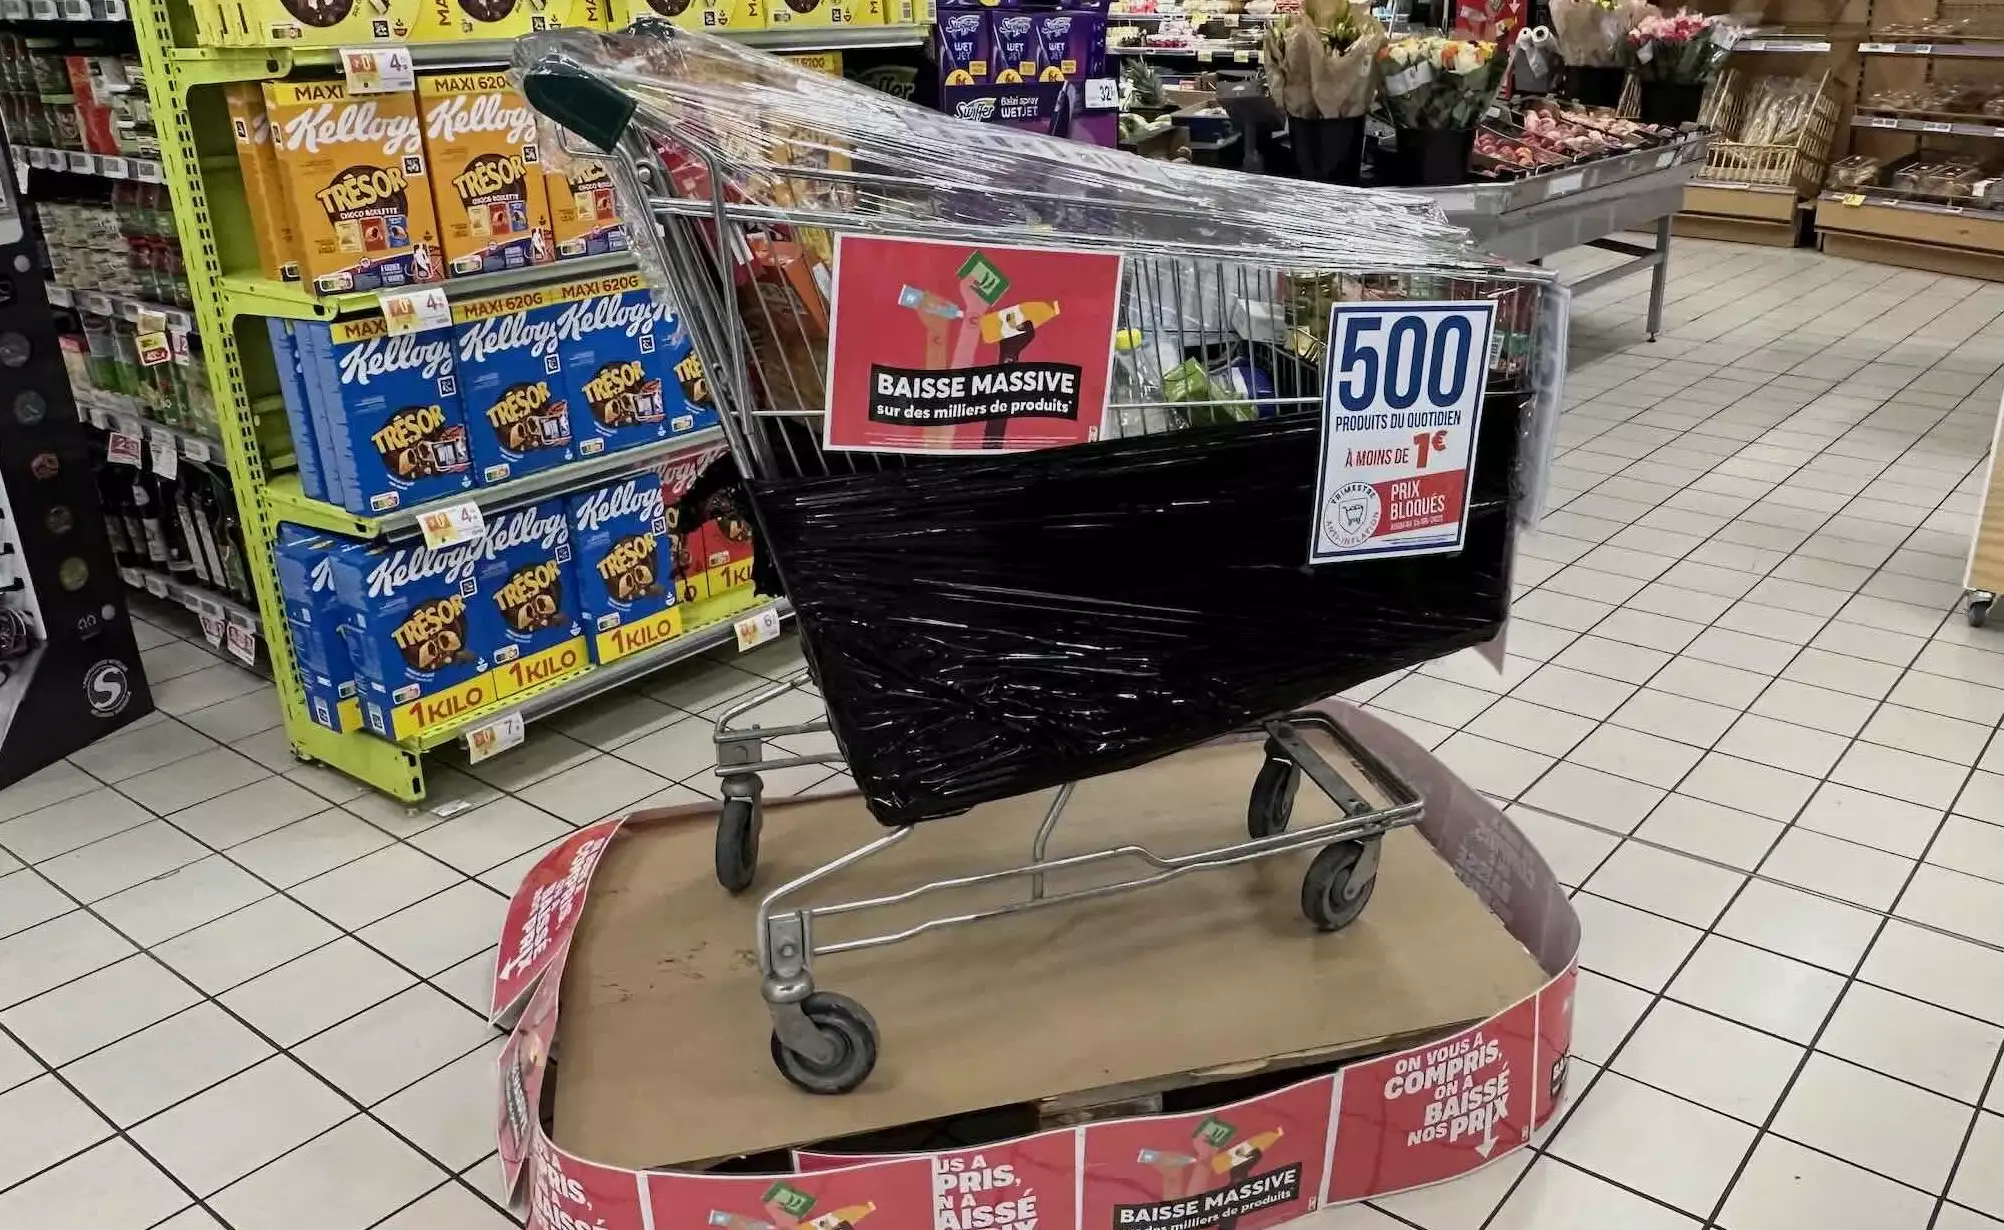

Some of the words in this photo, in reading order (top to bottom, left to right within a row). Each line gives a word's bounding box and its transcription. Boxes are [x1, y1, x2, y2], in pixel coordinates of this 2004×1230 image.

[954, 42, 973, 51] WET
[1007, 42, 1024, 52] WET
[1049, 42, 1065, 52] WET
[295, 84, 344, 101] MAXI
[435, 78, 475, 92] MAXI
[478, 76, 512, 90] 620
[562, 285, 600, 300] MAXI
[603, 276, 639, 293] 620G
[464, 302, 502, 319] MAXI
[505, 292, 543, 311] 620G
[344, 319, 387, 338] MAX
[1338, 315, 1473, 412] 500
[877, 373, 966, 399] BAISSE
[971, 371, 1075, 396] MASSIVE
[877, 404, 901, 417] sur
[904, 402, 931, 419] des
[934, 402, 987, 419] milliers
[990, 399, 1007, 414] de
[1336, 412, 1388, 432] PRODUITS
[1390, 412, 1405, 430] DU
[1407, 410, 1461, 429] QUOTIDIEN
[1345, 448, 1355, 468] À
[1356, 448, 1392, 466] MOINS
[1394, 447, 1410, 465] DE
[1331, 484, 1376, 504] TRIMESTRE
[1391, 479, 1420, 499] PRIX
[1390, 495, 1445, 521] BLOQUÉS
[1395, 1055, 1421, 1075] ON
[1427, 1039, 1469, 1065] VOUS
[1473, 1031, 1483, 1048] A
[1384, 1039, 1503, 1100] COMPRIS,
[1424, 1062, 1510, 1127] BAISSÉ
[1434, 1081, 1458, 1099] ON
[1463, 1075, 1474, 1091] A
[1407, 1122, 1448, 1147] NOS
[1449, 1092, 1510, 1143] PRIX
[938, 1158, 965, 1174] US
[970, 1154, 987, 1170] A
[960, 1193, 977, 1208] A
[1120, 1201, 1199, 1224] BAISSE
[1204, 1168, 1297, 1211] MASSIVE
[938, 1187, 1037, 1230] AISSÉ
[1222, 1206, 1239, 1219] de
